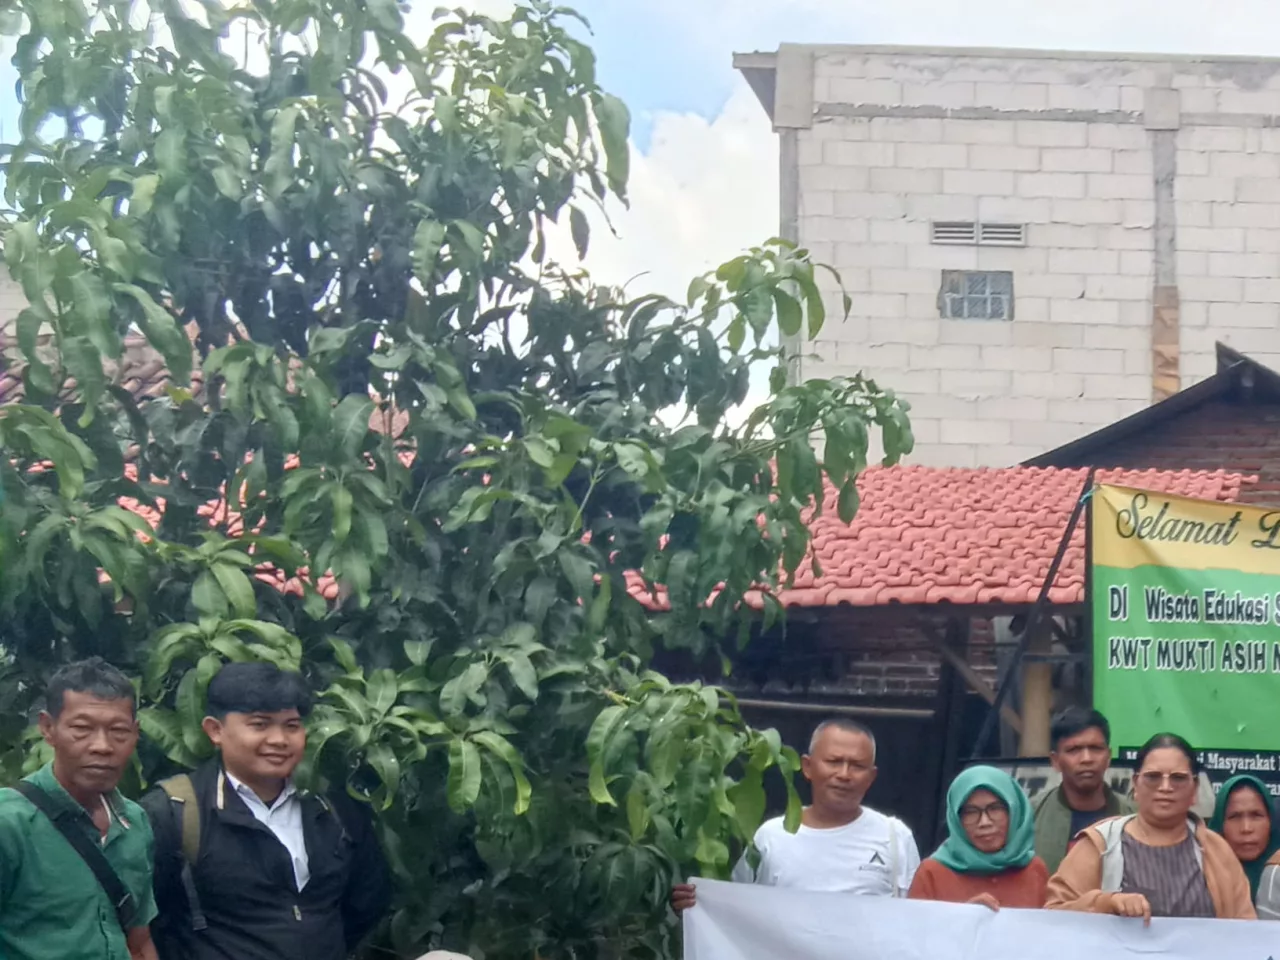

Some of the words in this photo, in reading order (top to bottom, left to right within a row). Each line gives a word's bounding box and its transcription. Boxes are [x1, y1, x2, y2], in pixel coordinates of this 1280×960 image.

[1116, 492, 1243, 546] Selamat
[1108, 585, 1129, 622] DI
[1144, 585, 1199, 623] Wisata
[1204, 588, 1269, 624] Edukasi
[1108, 637, 1152, 670] KWT
[1156, 638, 1216, 672] MUKTI
[1221, 641, 1266, 673] ASIH
[1208, 753, 1276, 774] Masyarakat
